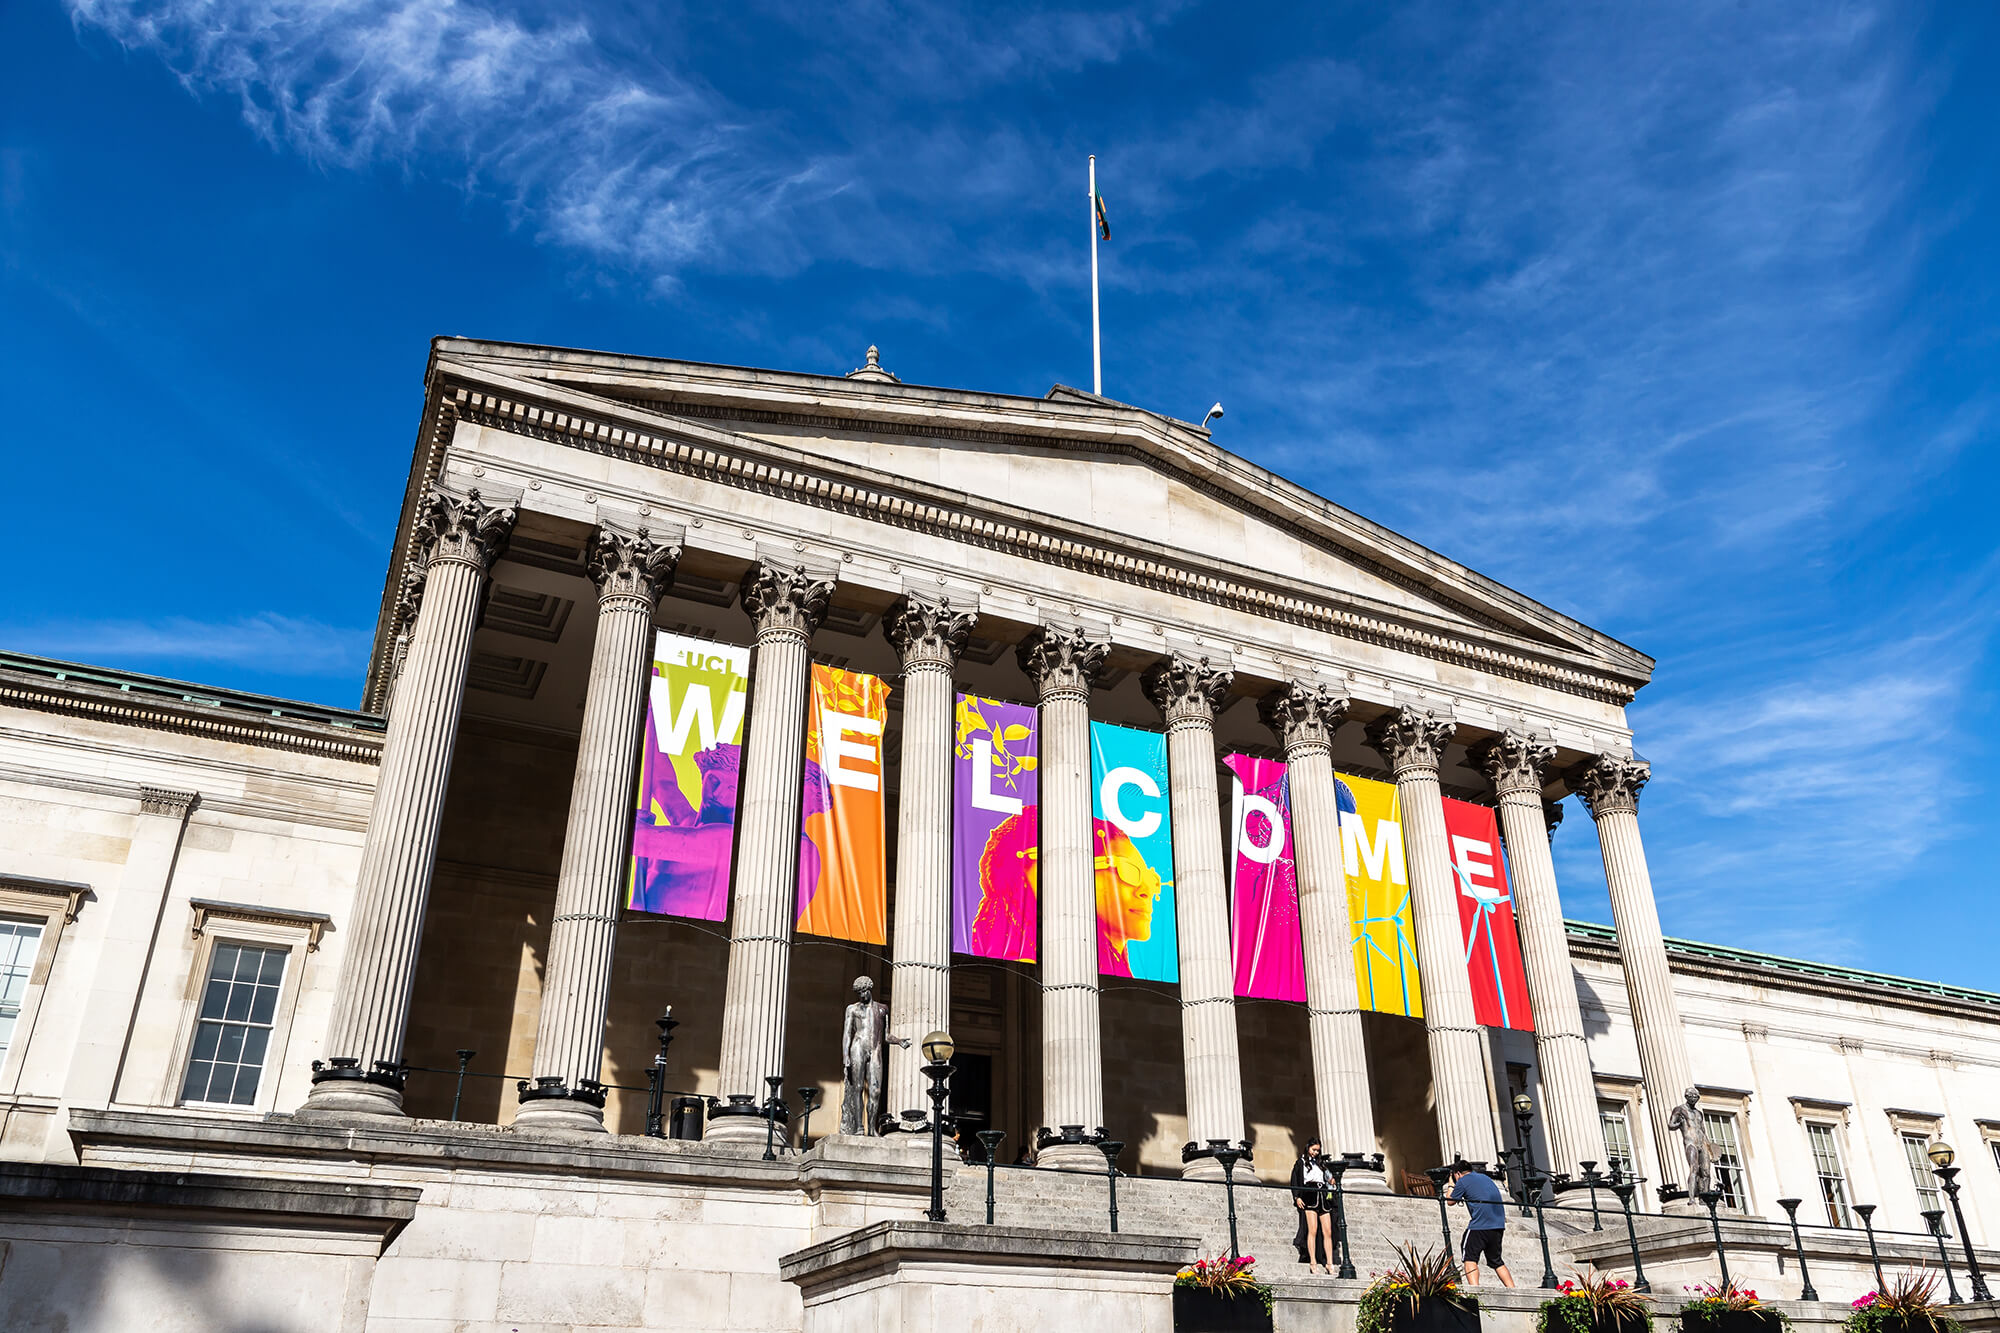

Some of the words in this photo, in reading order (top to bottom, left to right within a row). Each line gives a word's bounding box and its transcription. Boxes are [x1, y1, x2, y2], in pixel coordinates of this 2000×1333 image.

[686, 651, 738, 676] UCL
[650, 675, 746, 757] W
[821, 708, 880, 792] E
[971, 738, 1023, 815] L
[1101, 766, 1162, 838] C
[1339, 811, 1406, 886] M
[1452, 834, 1500, 901] E
